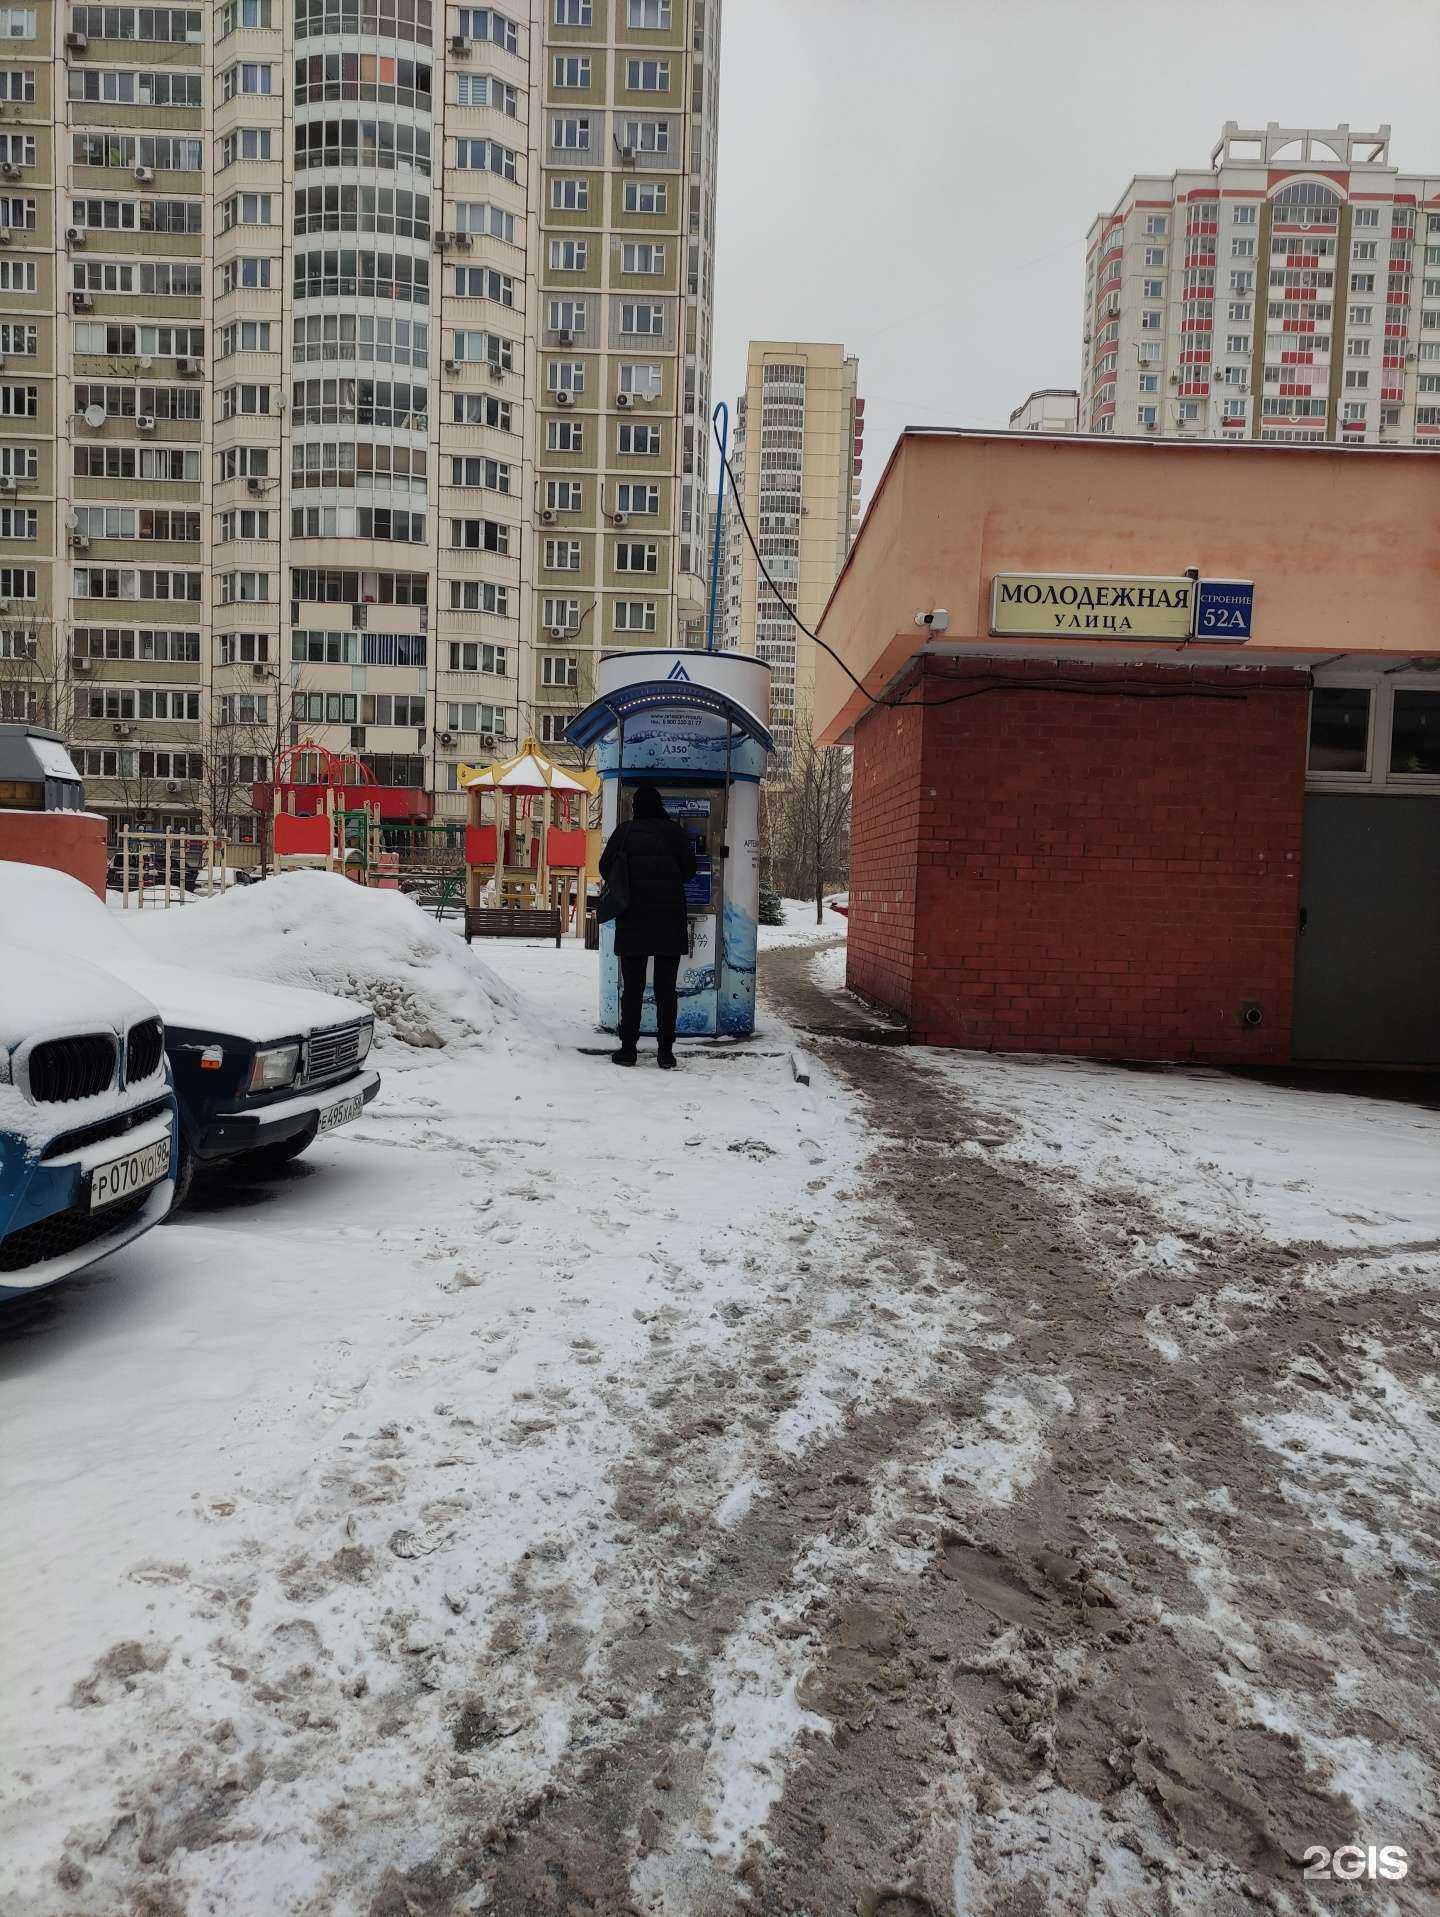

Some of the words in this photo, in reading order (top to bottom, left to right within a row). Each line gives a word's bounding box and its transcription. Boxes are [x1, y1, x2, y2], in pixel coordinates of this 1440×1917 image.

[1000, 584, 1190, 610] МОЛОДЕЖНАЯ
[1200, 594, 1252, 605] СТРОЕНИЕ
[1054, 614, 1133, 631] УЛИЦА
[1203, 609, 1247, 629] 52А
[98, 1156, 154, 1200] Р070УО
